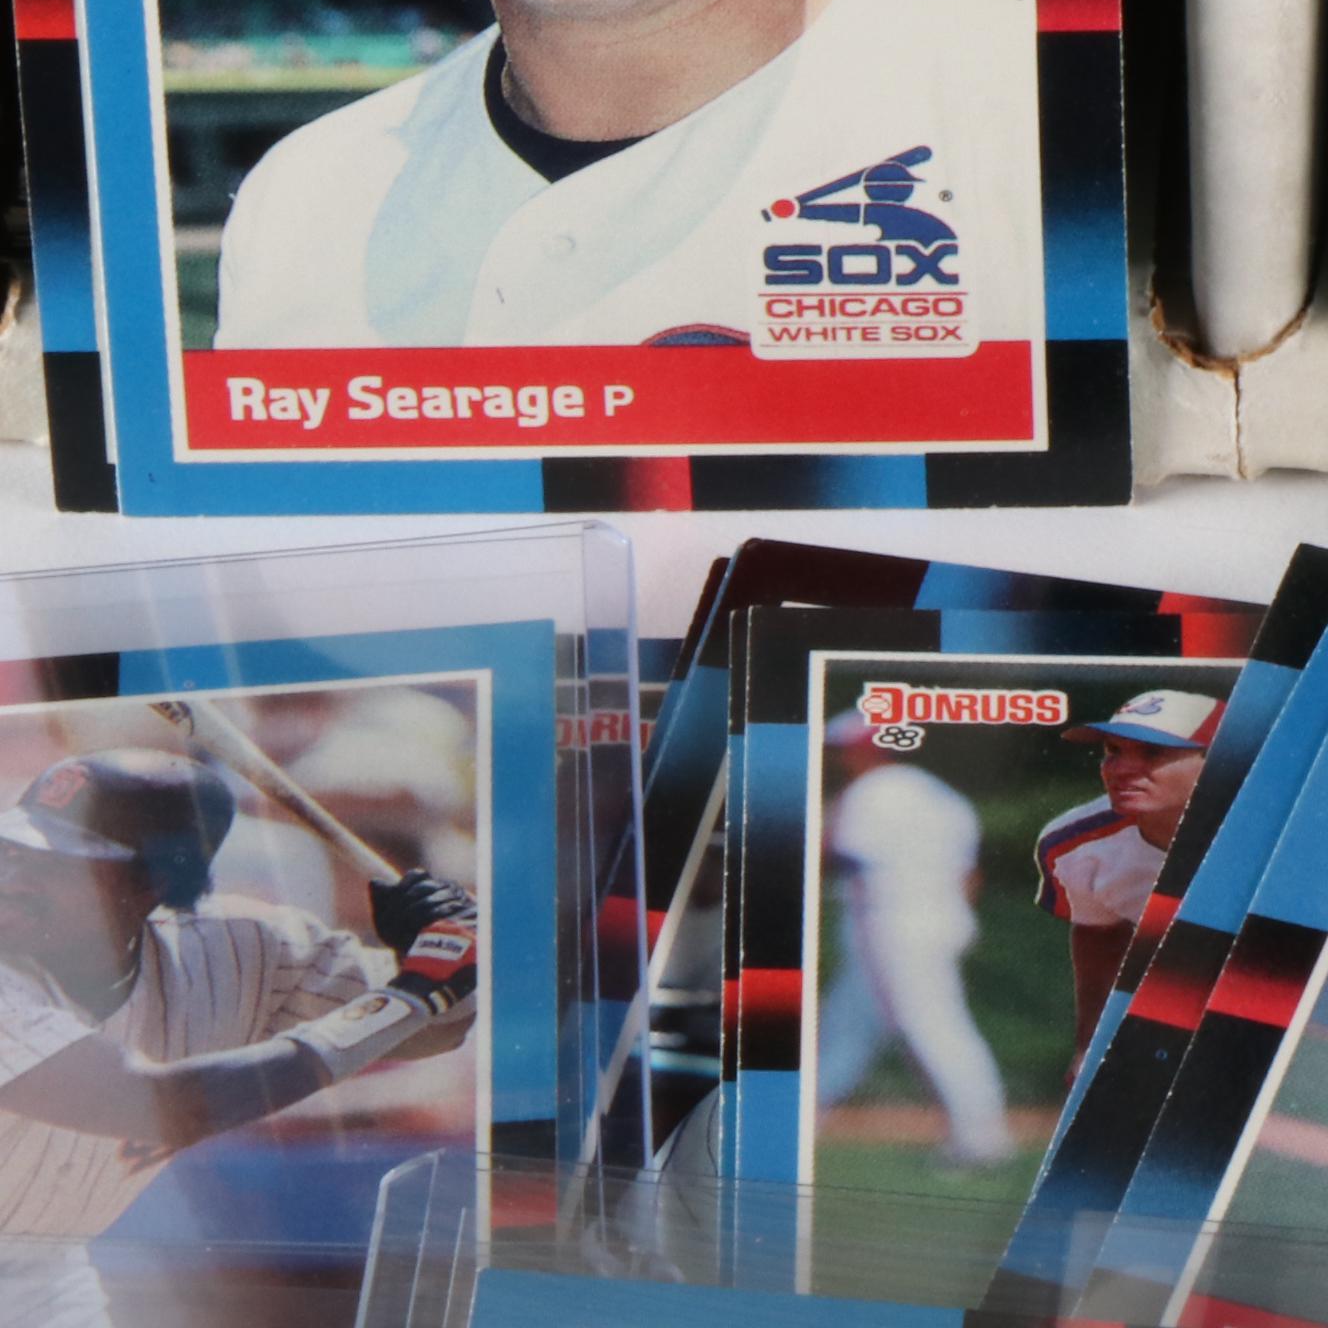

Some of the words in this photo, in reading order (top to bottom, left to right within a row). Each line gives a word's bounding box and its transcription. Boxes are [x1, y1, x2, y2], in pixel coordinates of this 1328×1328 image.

[762, 243, 960, 286] SOX
[764, 297, 965, 319] CHICAGO
[767, 326, 881, 343] WHITE
[889, 325, 963, 342] SOX
[226, 377, 330, 429] Ray
[347, 375, 585, 428] Searage
[603, 385, 635, 417] P
[862, 687, 1062, 725] DONRUSS
